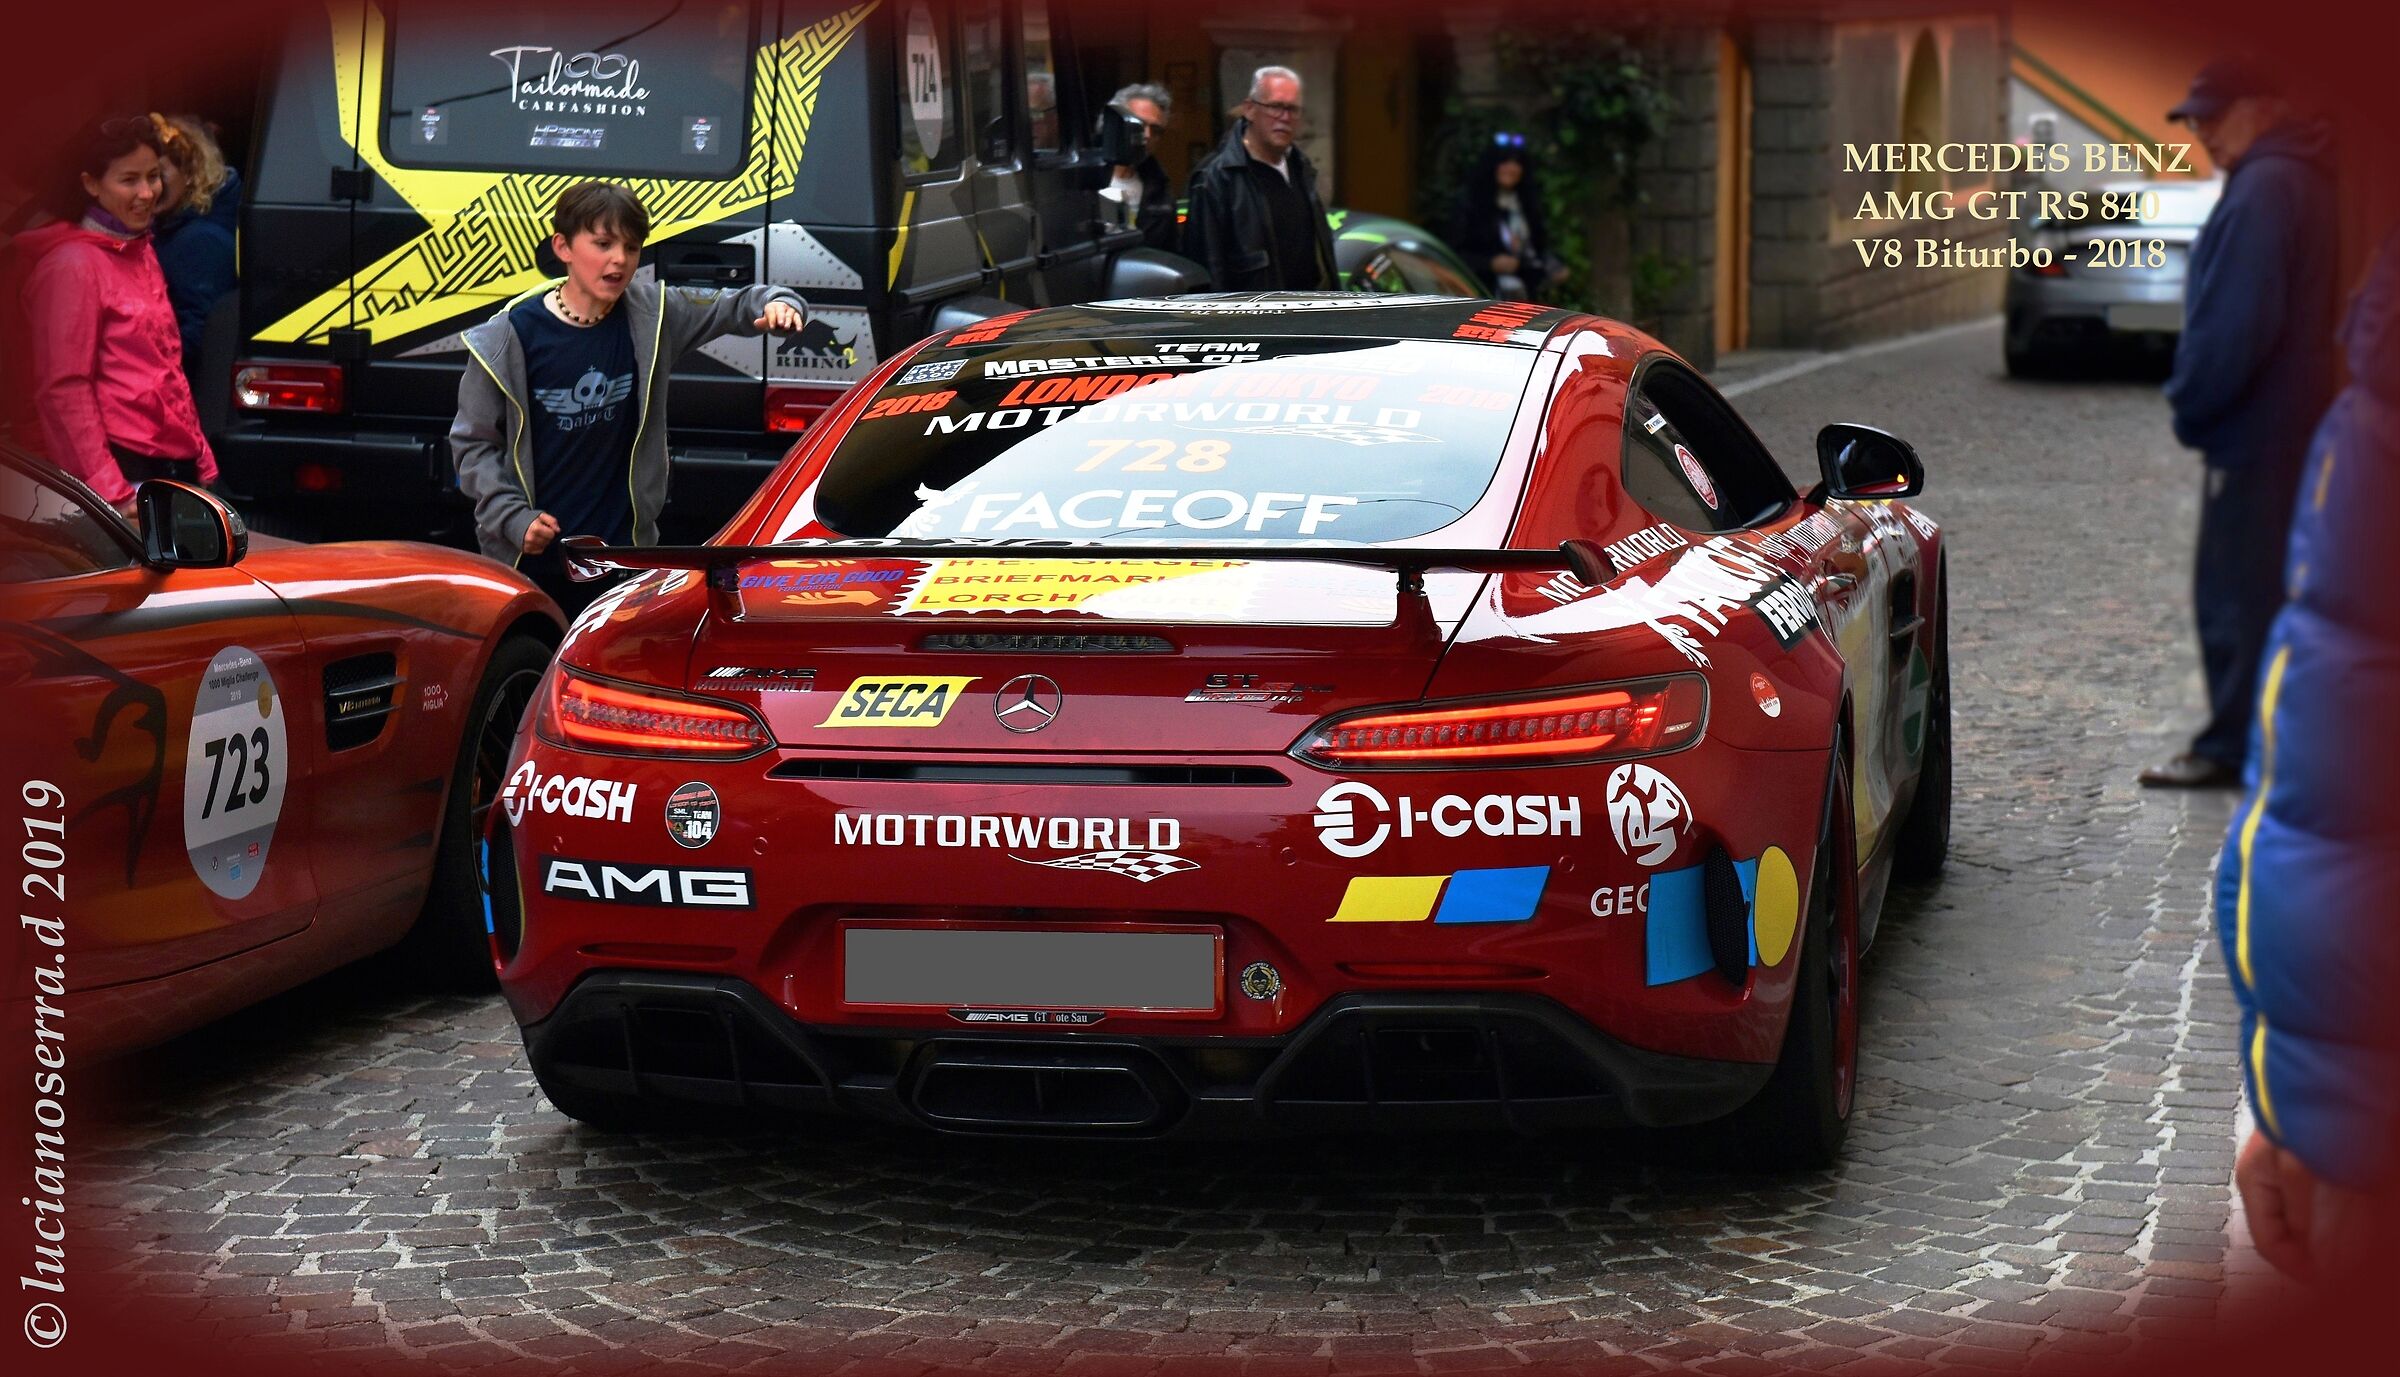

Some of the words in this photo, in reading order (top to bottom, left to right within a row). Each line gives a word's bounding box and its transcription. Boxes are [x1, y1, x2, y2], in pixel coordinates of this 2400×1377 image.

[490, 46, 650, 103] Tailormade
[912, 53, 937, 103] 724
[518, 100, 645, 116] CARFASHION
[776, 356, 851, 370] RHINO
[843, 347, 858, 365] 2
[1155, 342, 1261, 353] TEAM
[985, 354, 1192, 378] MASTERS
[1200, 355, 1261, 364] OF
[861, 390, 958, 420] 2018
[998, 373, 1206, 407] LONDON
[1210, 373, 1382, 401] TOKYO
[924, 401, 1422, 436] MOTORWORLD
[1074, 438, 1233, 473] 728
[960, 489, 1358, 534] FACEOFF
[740, 574, 794, 589] GIVE
[795, 572, 841, 587] FOR
[843, 569, 905, 583] GOOD
[1536, 522, 1690, 605] MORWORLD
[424, 685, 441, 697] 1000
[694, 680, 814, 693] MOTORWORLD
[1206, 674, 1259, 688] GT
[840, 683, 950, 718] SECA
[202, 727, 269, 820] 723
[685, 820, 713, 839] 104
[834, 813, 1181, 850] MOTORWORLD
[545, 861, 749, 905] AMG
[1034, 1012, 1047, 1022] GT
[1071, 1012, 1088, 1023] Sau
